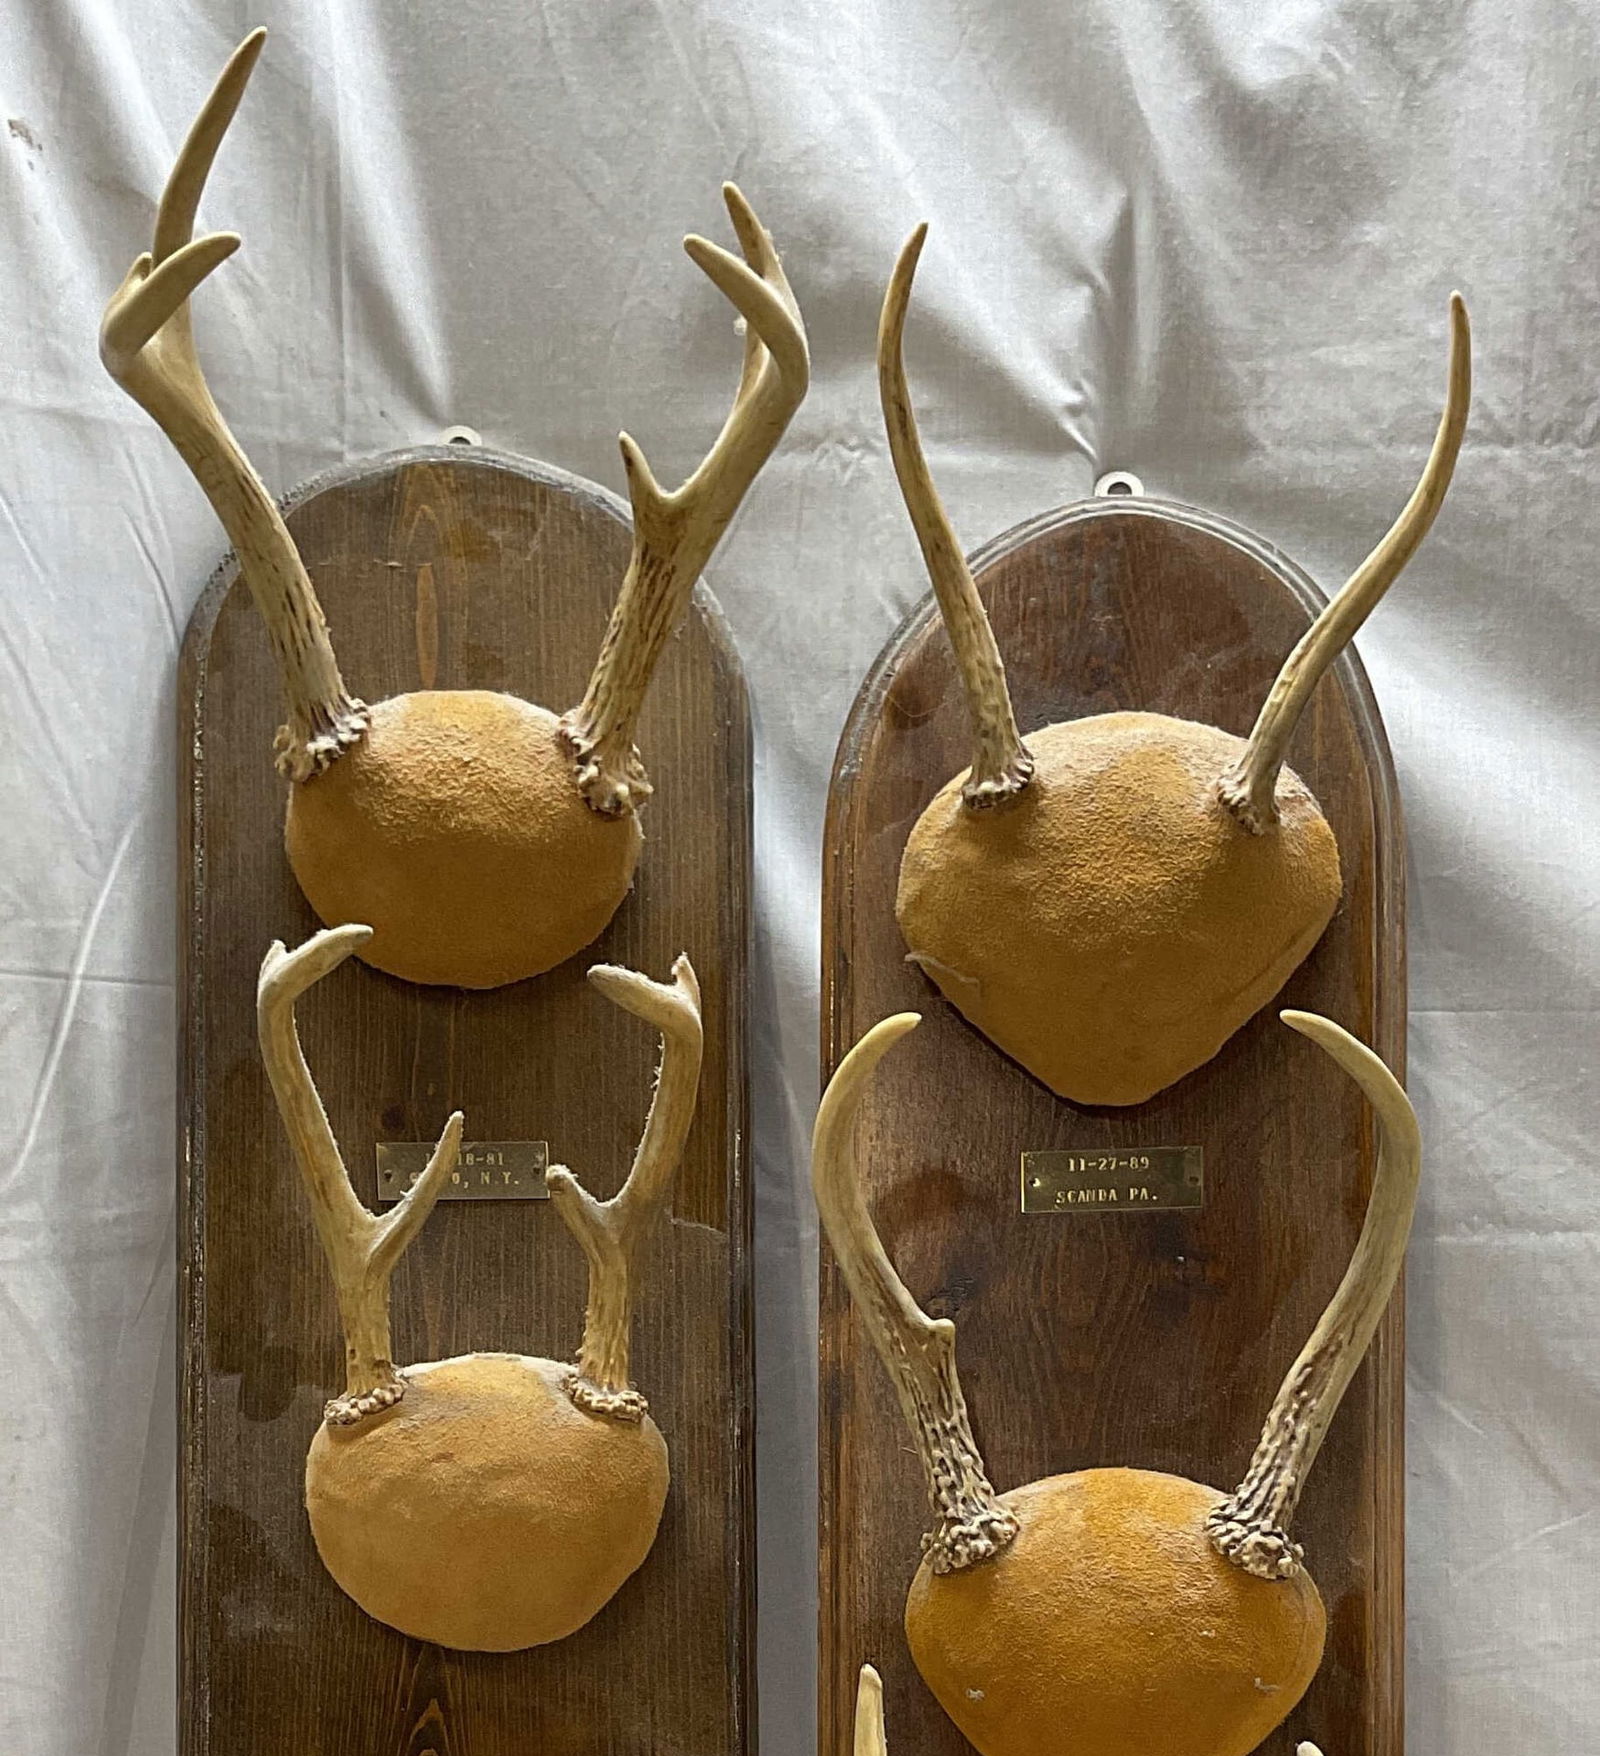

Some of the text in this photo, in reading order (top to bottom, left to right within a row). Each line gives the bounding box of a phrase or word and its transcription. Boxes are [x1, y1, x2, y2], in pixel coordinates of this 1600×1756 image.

[425, 1152, 504, 1166] 118-81
[1068, 1156, 1150, 1172] 11-27-89
[409, 1171, 519, 1188] OO, N.Y.
[1056, 1187, 1157, 1204] SCANDA PA.
